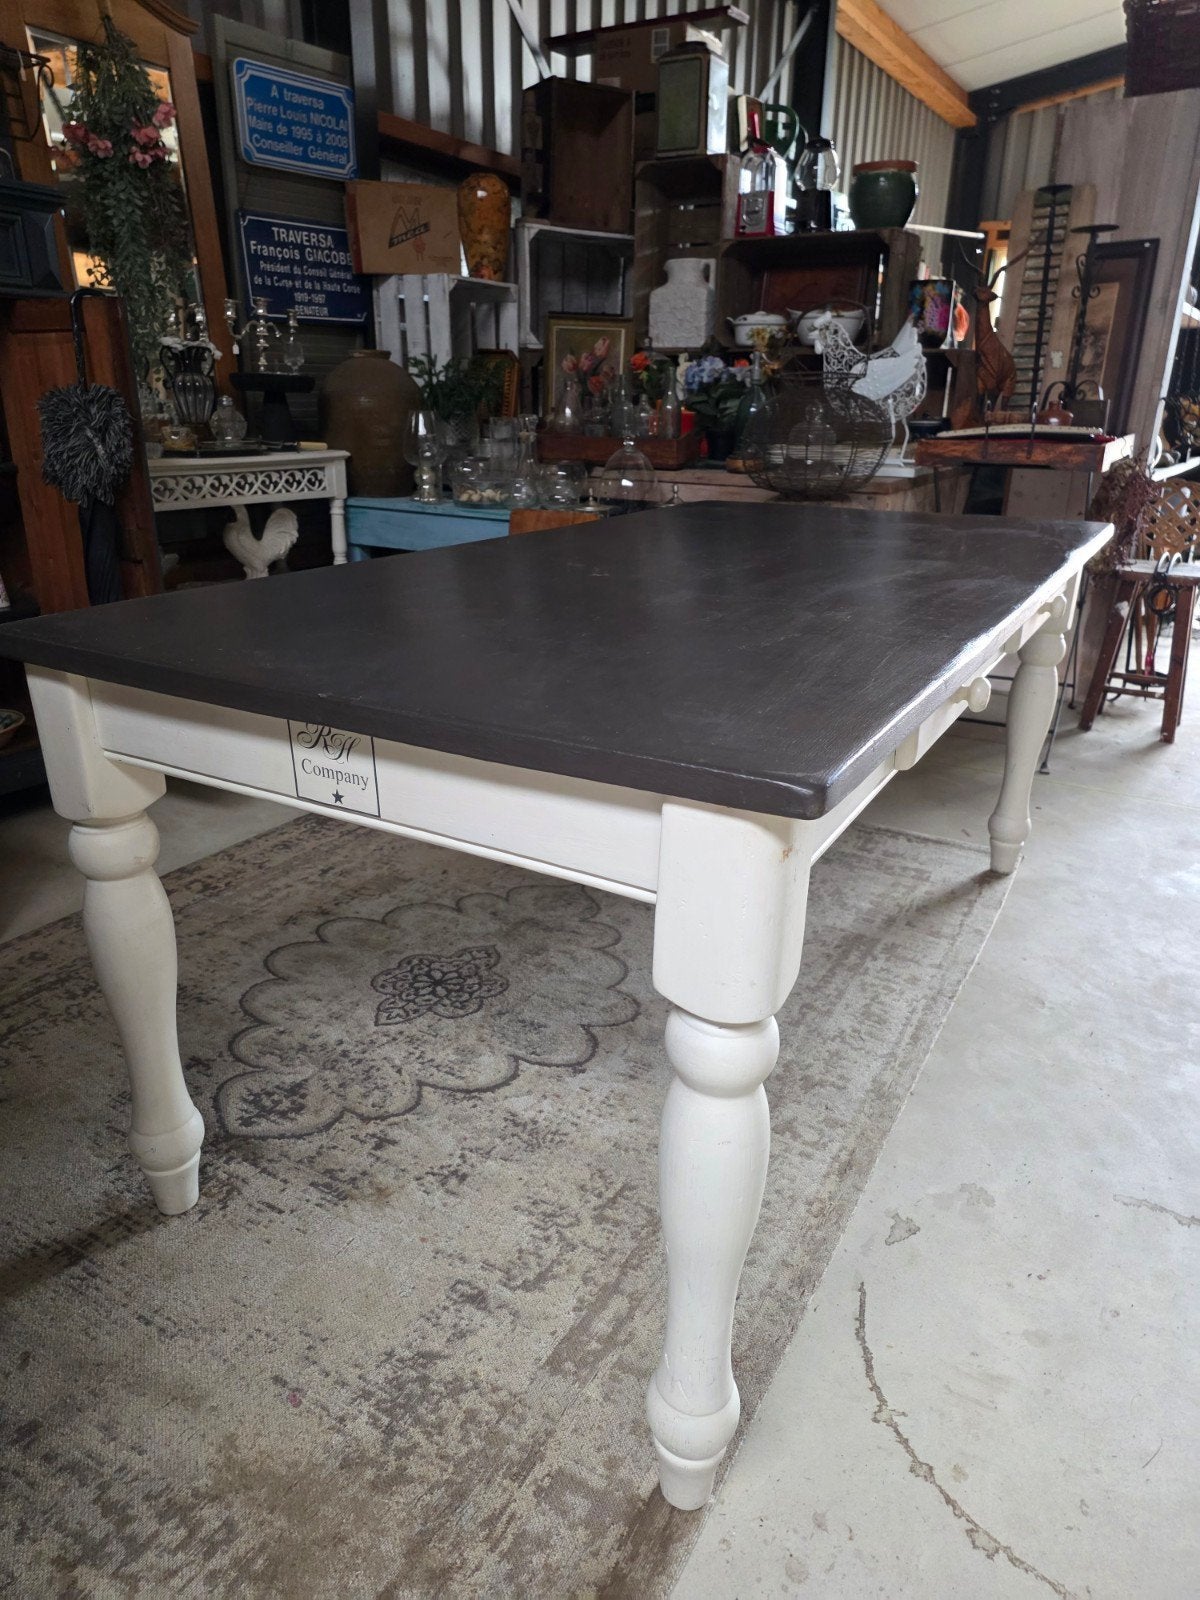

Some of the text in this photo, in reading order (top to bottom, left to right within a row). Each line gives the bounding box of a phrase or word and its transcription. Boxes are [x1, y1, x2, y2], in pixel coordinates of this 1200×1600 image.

[270, 85, 324, 110] A traversa
[246, 97, 278, 116] Pierre
[279, 106, 307, 123] Louis
[248, 115, 273, 132] Maire
[276, 123, 288, 136] de
[291, 126, 313, 141] 1995
[325, 133, 348, 148] 2008
[252, 133, 303, 156] Conseiller
[271, 226, 335, 249] TRAVERSA
[249, 240, 300, 260] François
[253, 274, 263, 285] de
[264, 275, 271, 286] la
[295, 279, 302, 289] et
[304, 280, 313, 290] de
[314, 280, 321, 290] la
[293, 264, 302, 275] du
[303, 265, 327, 278] Conseil
[301, 758, 369, 791] Company
